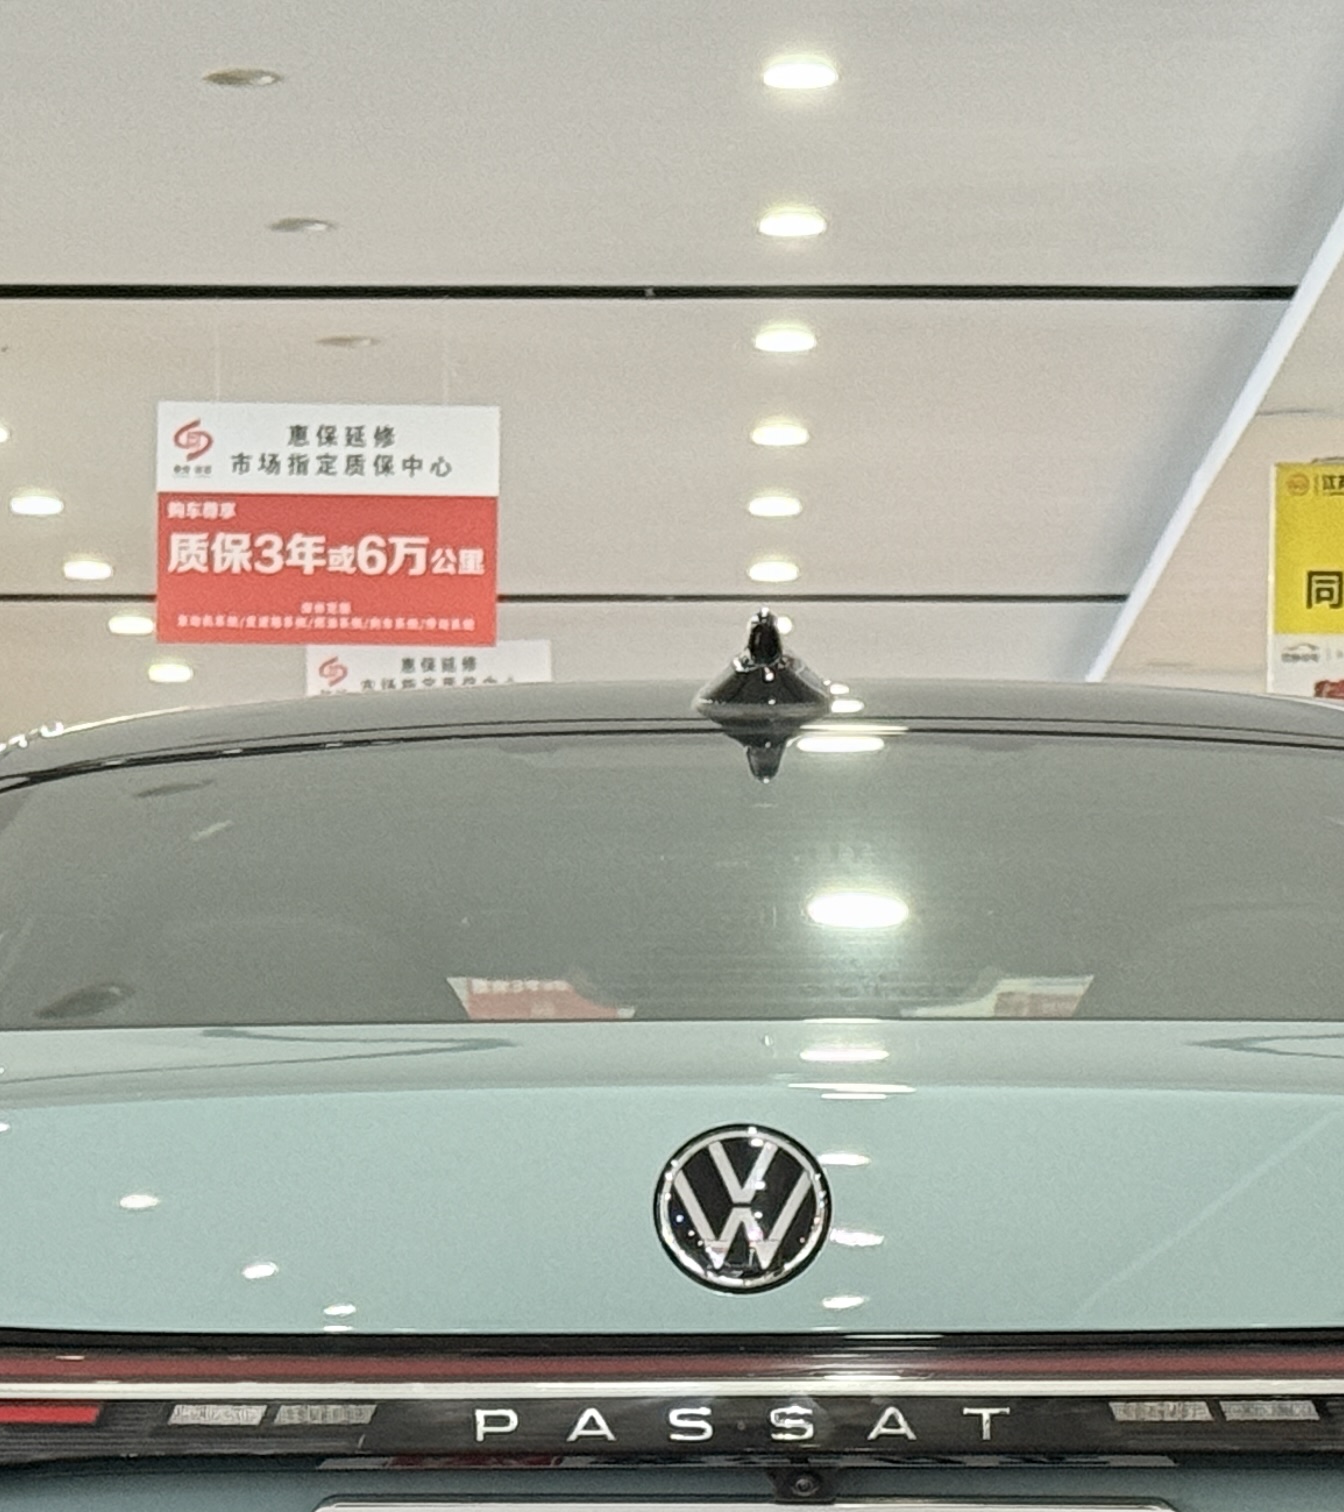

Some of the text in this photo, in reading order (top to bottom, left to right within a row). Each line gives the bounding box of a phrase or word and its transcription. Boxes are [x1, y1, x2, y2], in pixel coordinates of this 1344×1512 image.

[287, 424, 397, 448] 惠保延修
[230, 451, 453, 478] 市场指定质保中心
[167, 532, 486, 576] 质保3年或6万公里
[475, 1407, 1011, 1442] PASSAT
